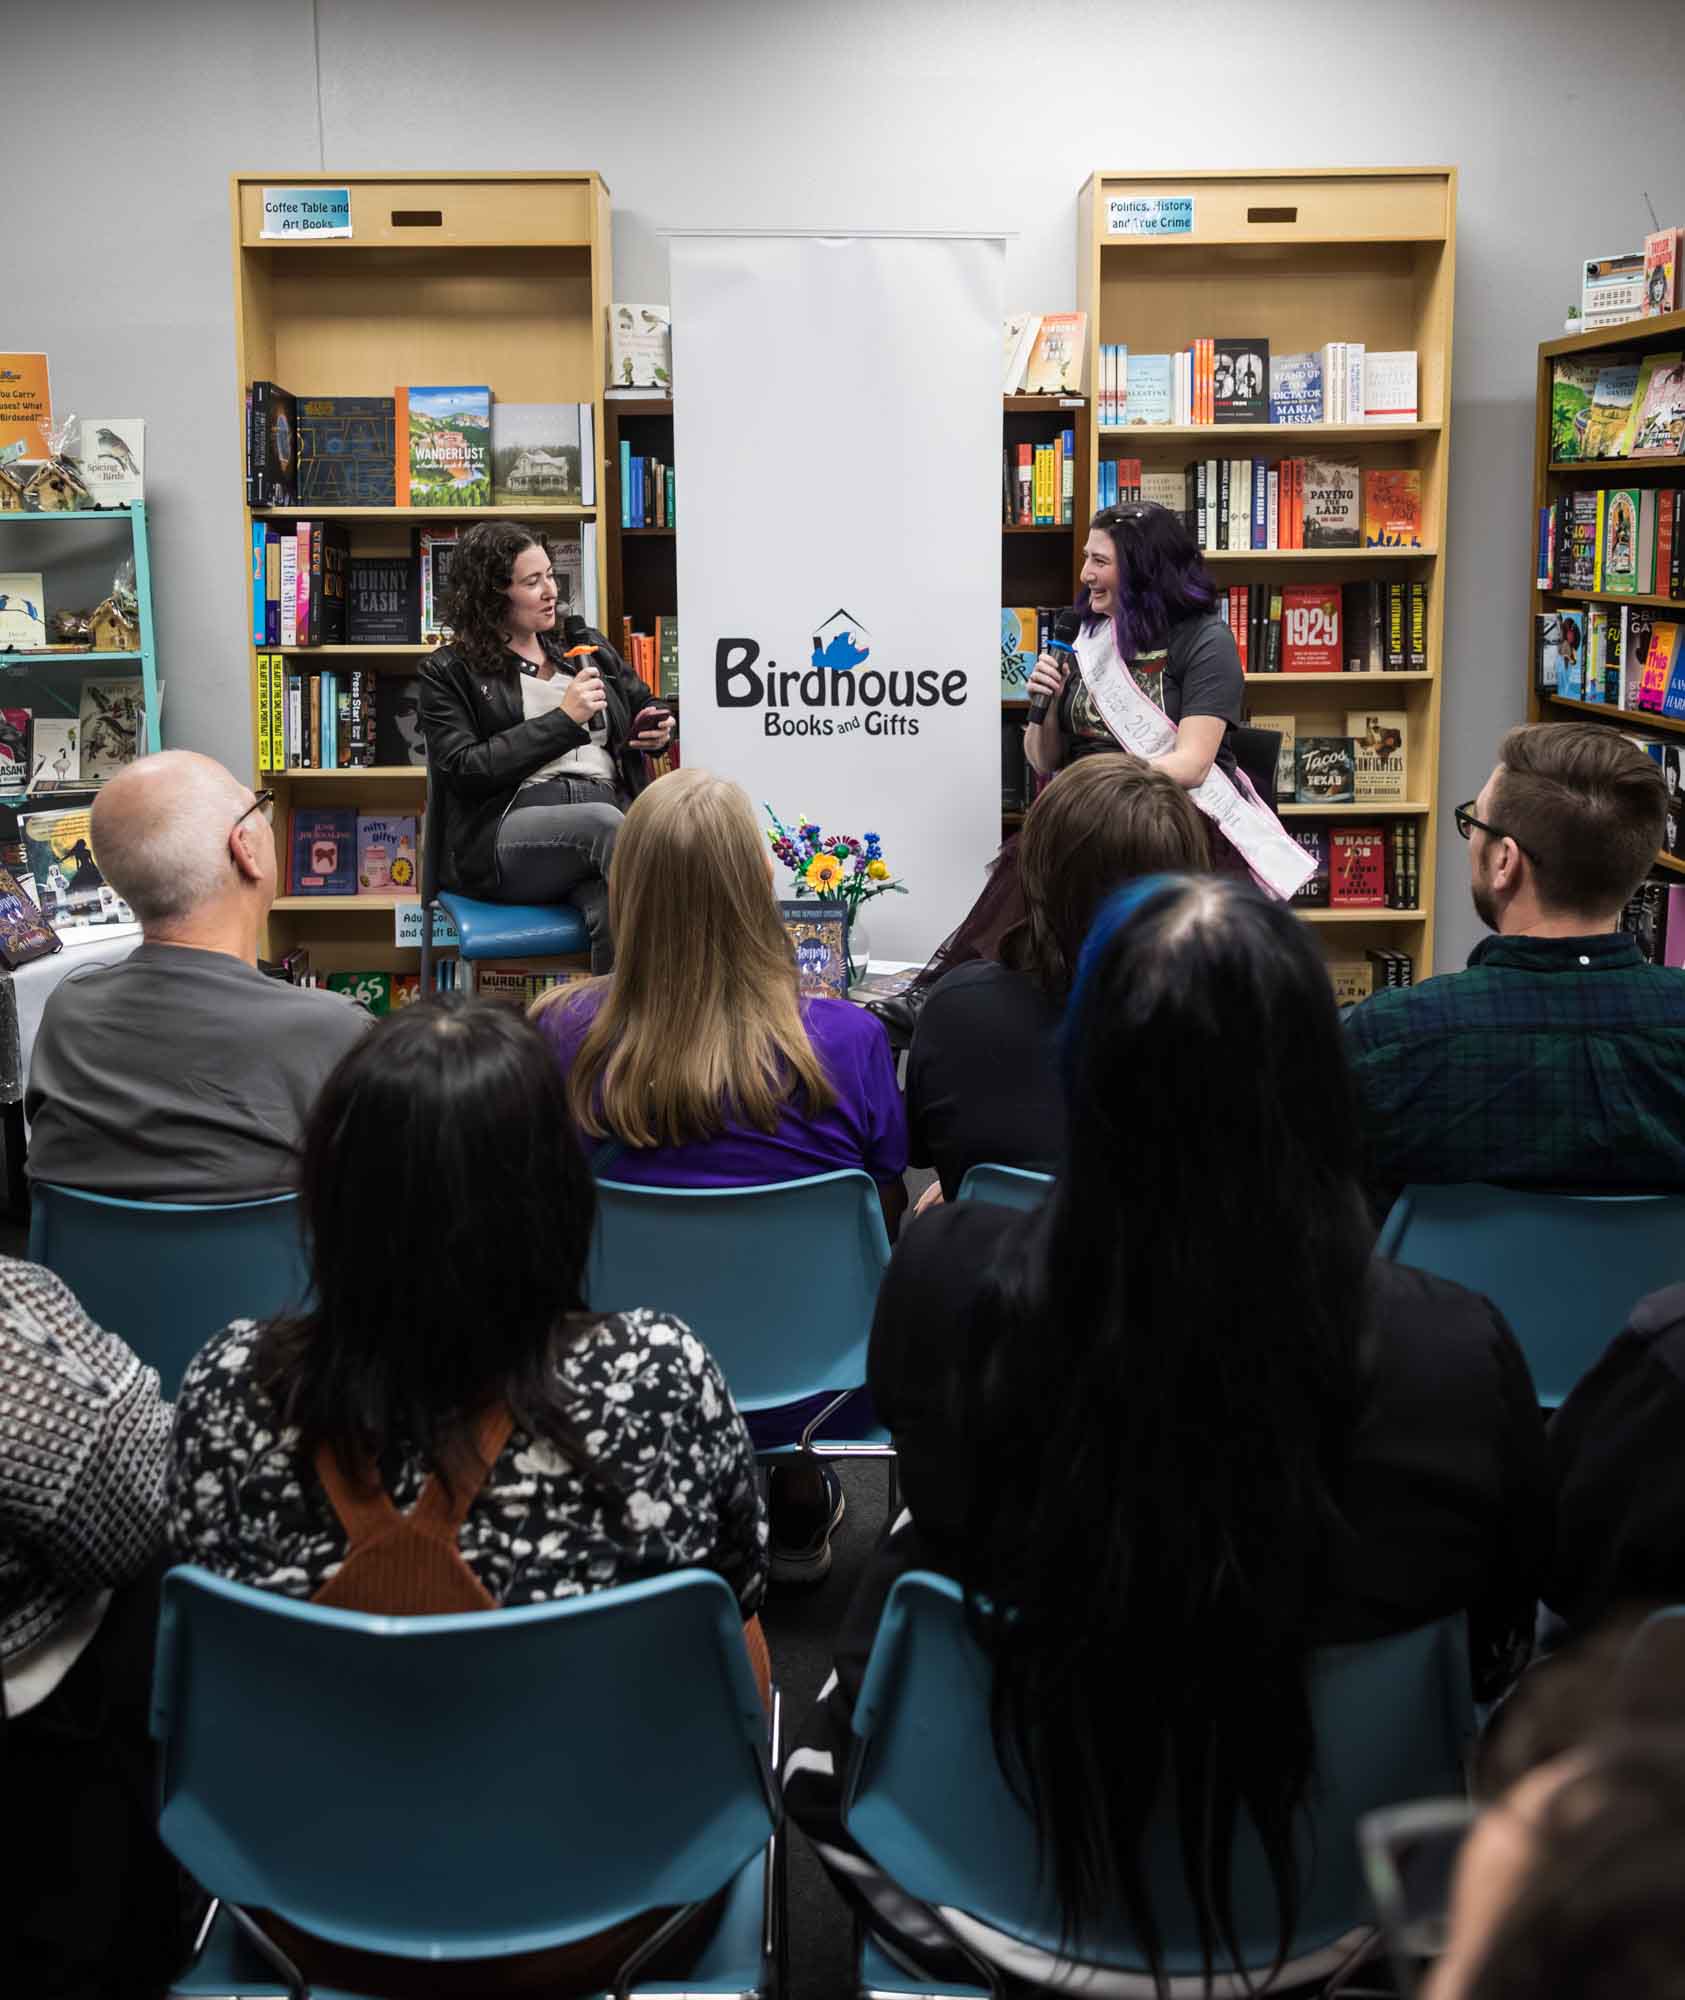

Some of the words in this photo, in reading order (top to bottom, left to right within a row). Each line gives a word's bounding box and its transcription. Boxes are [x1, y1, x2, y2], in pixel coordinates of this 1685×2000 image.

[265, 202, 298, 213] Coffee
[301, 202, 328, 213] Table
[330, 202, 349, 213] and
[282, 219, 299, 230] Art
[302, 219, 334, 230] Books
[1160, 217, 1191, 228] Crime
[12, 390, 36, 399] Carry
[1273, 389, 1321, 400] DICTATOR
[0, 401, 20, 409] uses?
[22, 402, 43, 410] What
[1276, 404, 1316, 416] MARIA
[1280, 415, 1312, 424] RESSA
[415, 446, 485, 461] WANDERLUST
[1256, 466, 1265, 498] FREEDOM
[1311, 489, 1354, 500] PAYING
[1256, 498, 1265, 525] SEASON
[1316, 505, 1349, 516] LAND
[350, 570, 409, 591] JOHNNY
[359, 591, 398, 612] CASH
[1285, 608, 1338, 646] 1929
[1000, 632, 1017, 656] HIS
[260, 660, 269, 671] THE
[274, 660, 282, 671] THE
[260, 671, 269, 681] ART
[274, 671, 282, 681] ART
[715, 636, 968, 708] Birdhouse
[352, 672, 361, 698] Press
[260, 689, 269, 699] THE
[274, 689, 282, 699] THE
[352, 699, 361, 722] Start
[260, 711, 269, 737] PORTRAIT
[274, 711, 282, 737] PORTRAIT
[764, 712, 834, 737] Books
[837, 715, 861, 735] and
[864, 710, 920, 737] Gifts
[1301, 749, 1347, 771] Tacos
[1, 766, 26, 776] ASANT
[1307, 775, 1343, 786] TEXAS
[1292, 832, 1319, 845] ACK
[1333, 836, 1382, 846] WHACK
[1343, 847, 1371, 857] JOB
[1298, 882, 1319, 895] GIC
[403, 913, 423, 923] Adu
[400, 928, 417, 938] and
[420, 927, 444, 938] Caft
